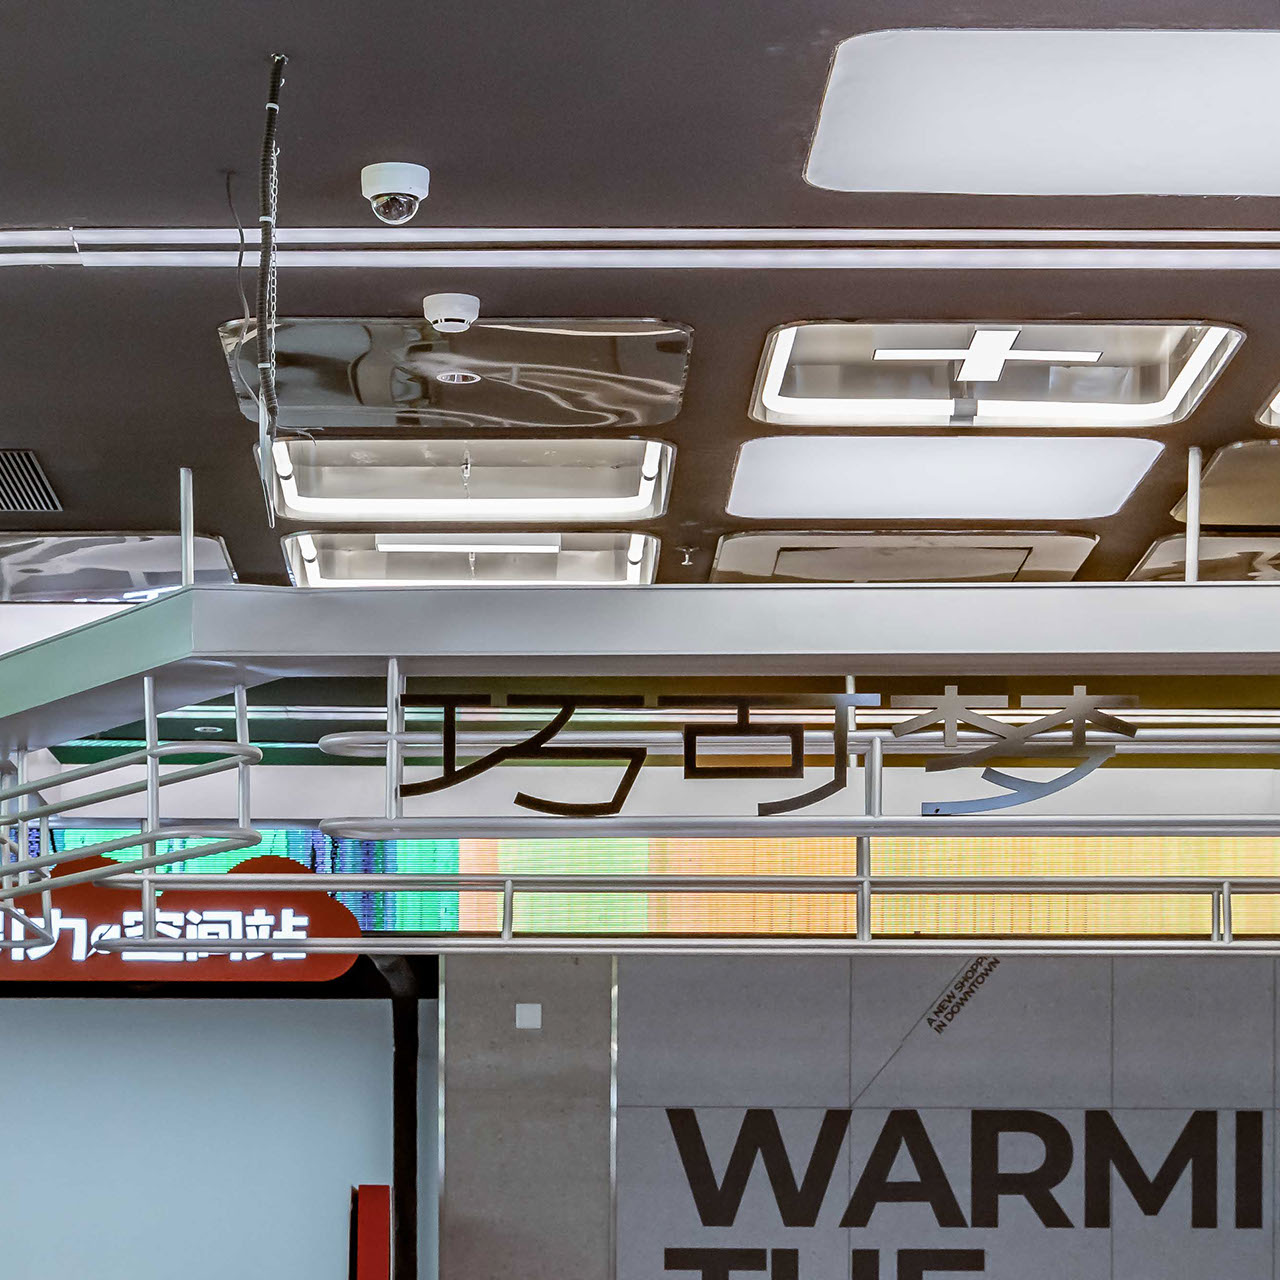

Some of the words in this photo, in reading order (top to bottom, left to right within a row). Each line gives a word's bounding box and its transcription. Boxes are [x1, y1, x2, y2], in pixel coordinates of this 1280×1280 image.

[926, 1017, 937, 1028] A
[933, 990, 957, 1018] NEW
[933, 1021, 947, 1034] IN
[943, 956, 1001, 1022] DOWNTOWN
